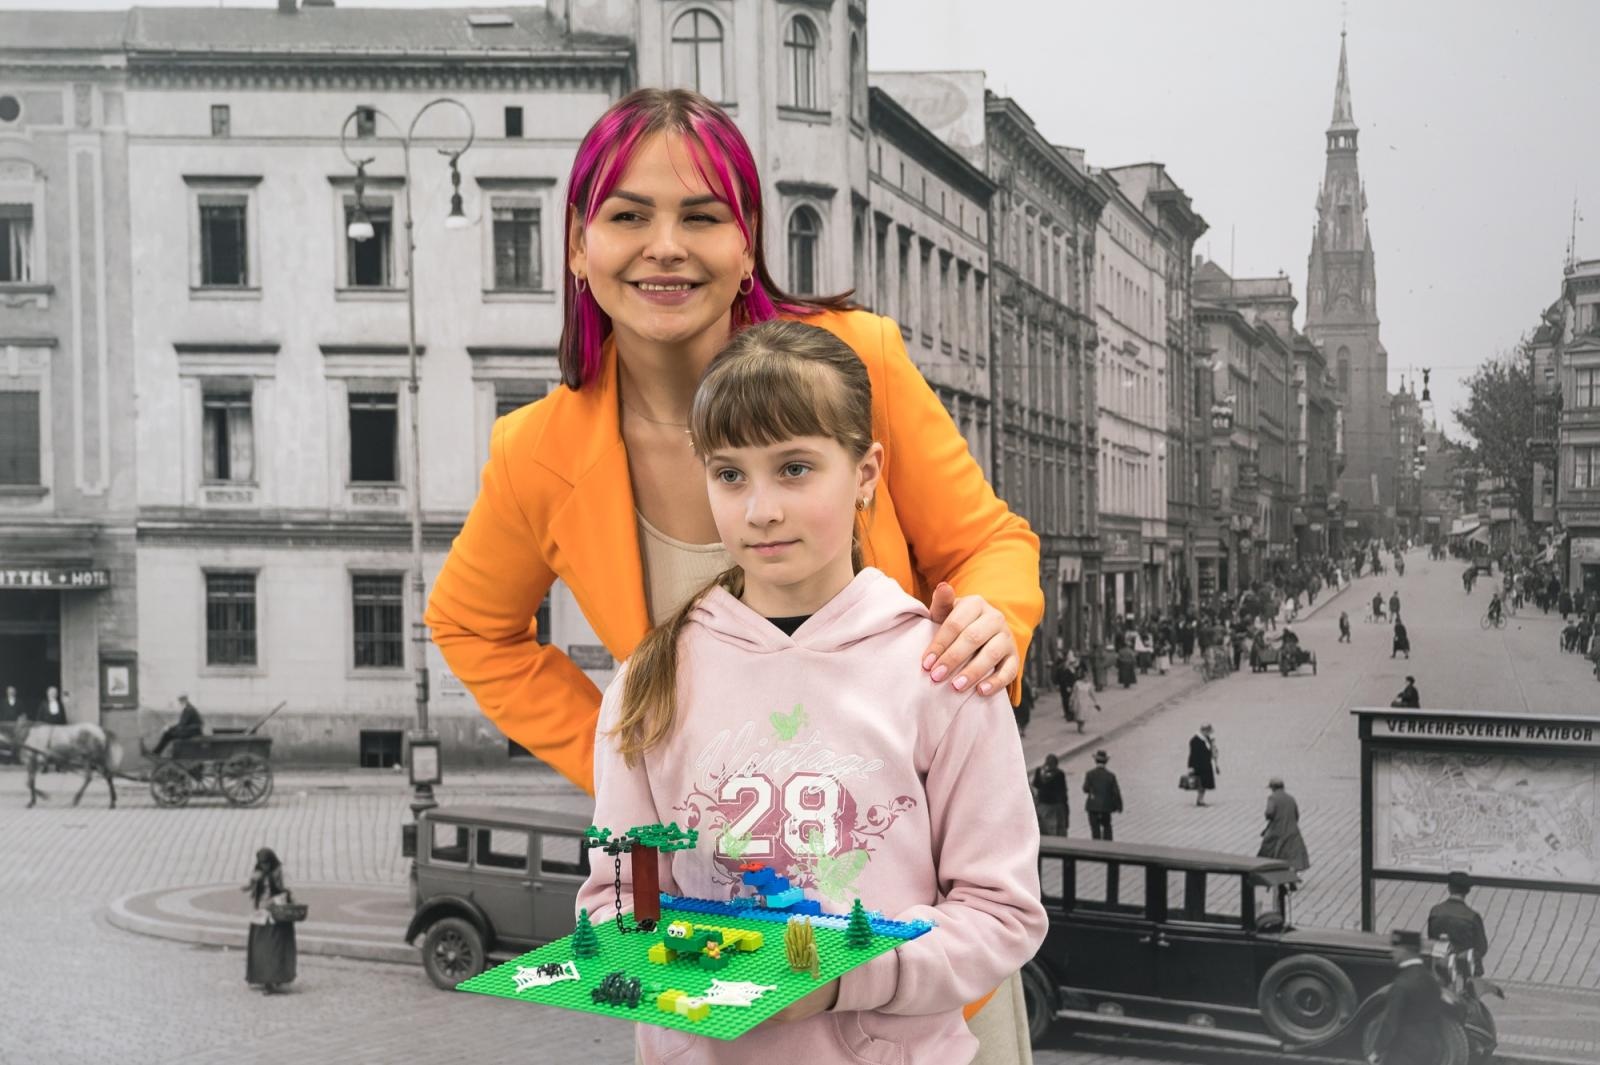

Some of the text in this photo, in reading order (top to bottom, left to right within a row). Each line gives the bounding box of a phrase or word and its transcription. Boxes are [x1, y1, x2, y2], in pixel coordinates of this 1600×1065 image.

[1387, 719, 1593, 742] VERKEHRSVEREIN RATIBOR
[714, 771, 847, 859] 28
